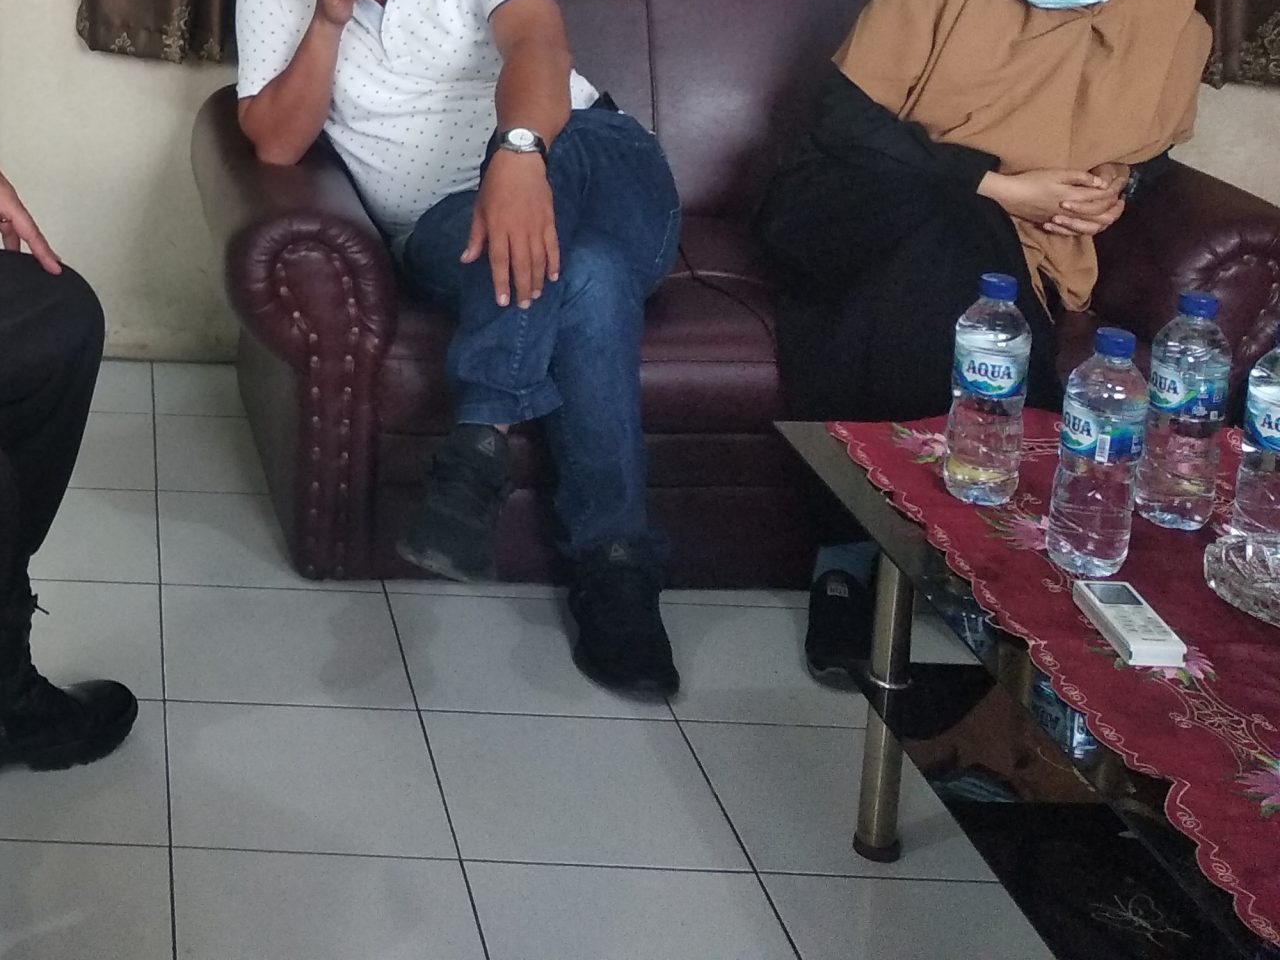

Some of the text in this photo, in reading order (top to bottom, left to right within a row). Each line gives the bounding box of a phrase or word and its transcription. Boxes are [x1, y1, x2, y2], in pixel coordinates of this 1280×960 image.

[966, 359, 1013, 381] AQUA
[1150, 371, 1179, 395] QUA
[1063, 411, 1092, 437] QUA
